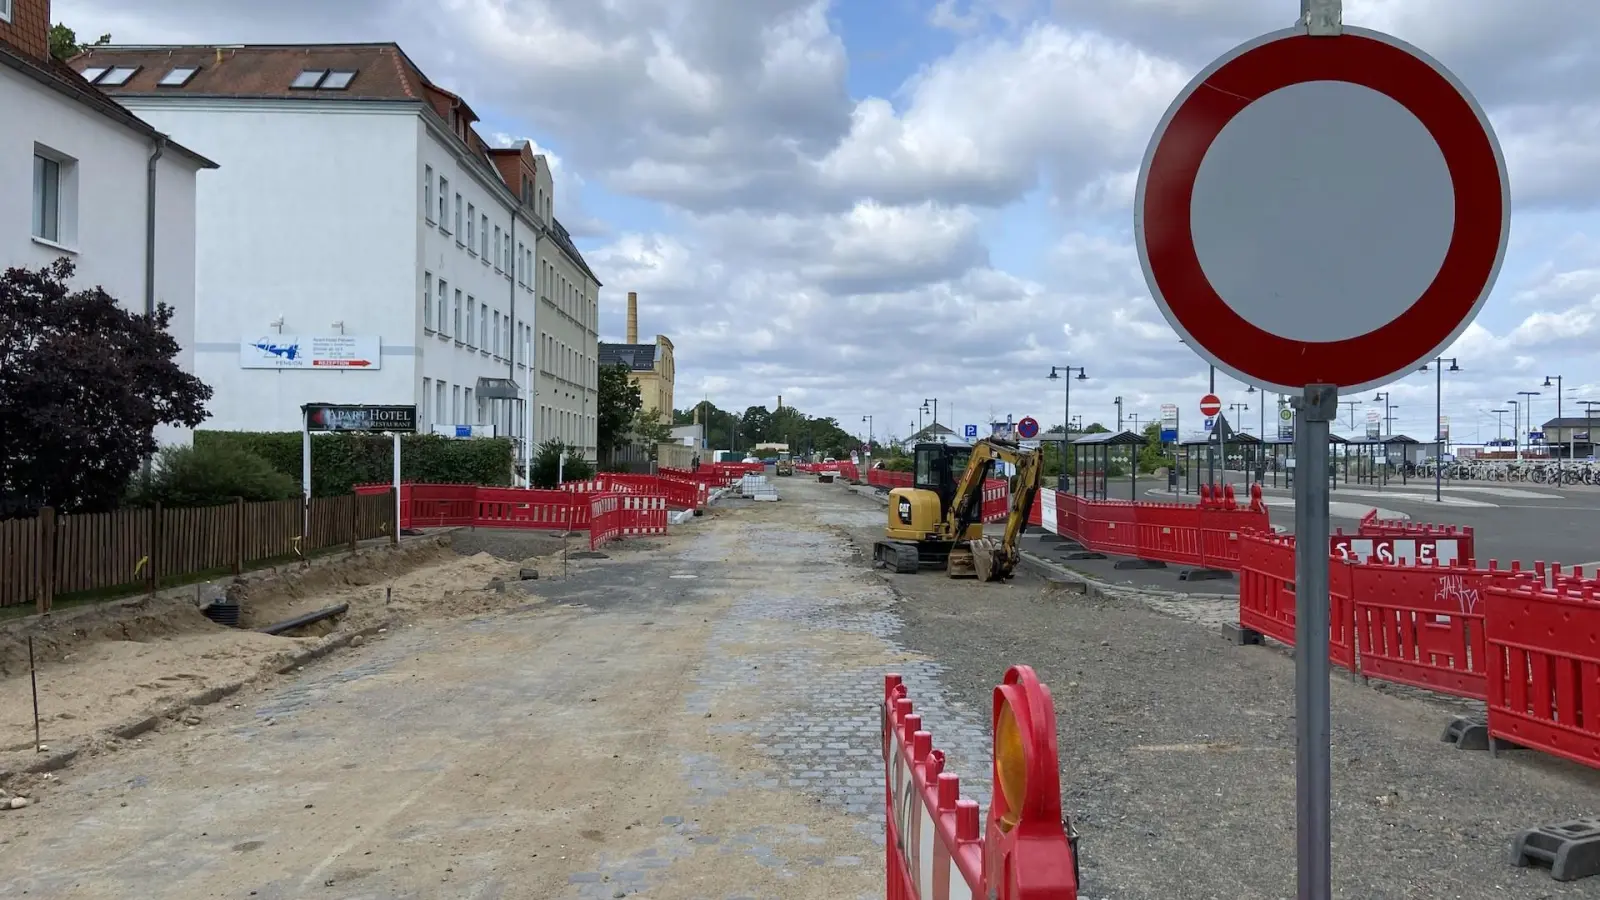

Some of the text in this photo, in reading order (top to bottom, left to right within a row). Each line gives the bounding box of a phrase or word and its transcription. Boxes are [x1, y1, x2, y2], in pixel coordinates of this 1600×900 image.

[370, 409, 411, 420] HOTEL
[967, 426, 973, 436] P
[899, 503, 910, 512] CAT
